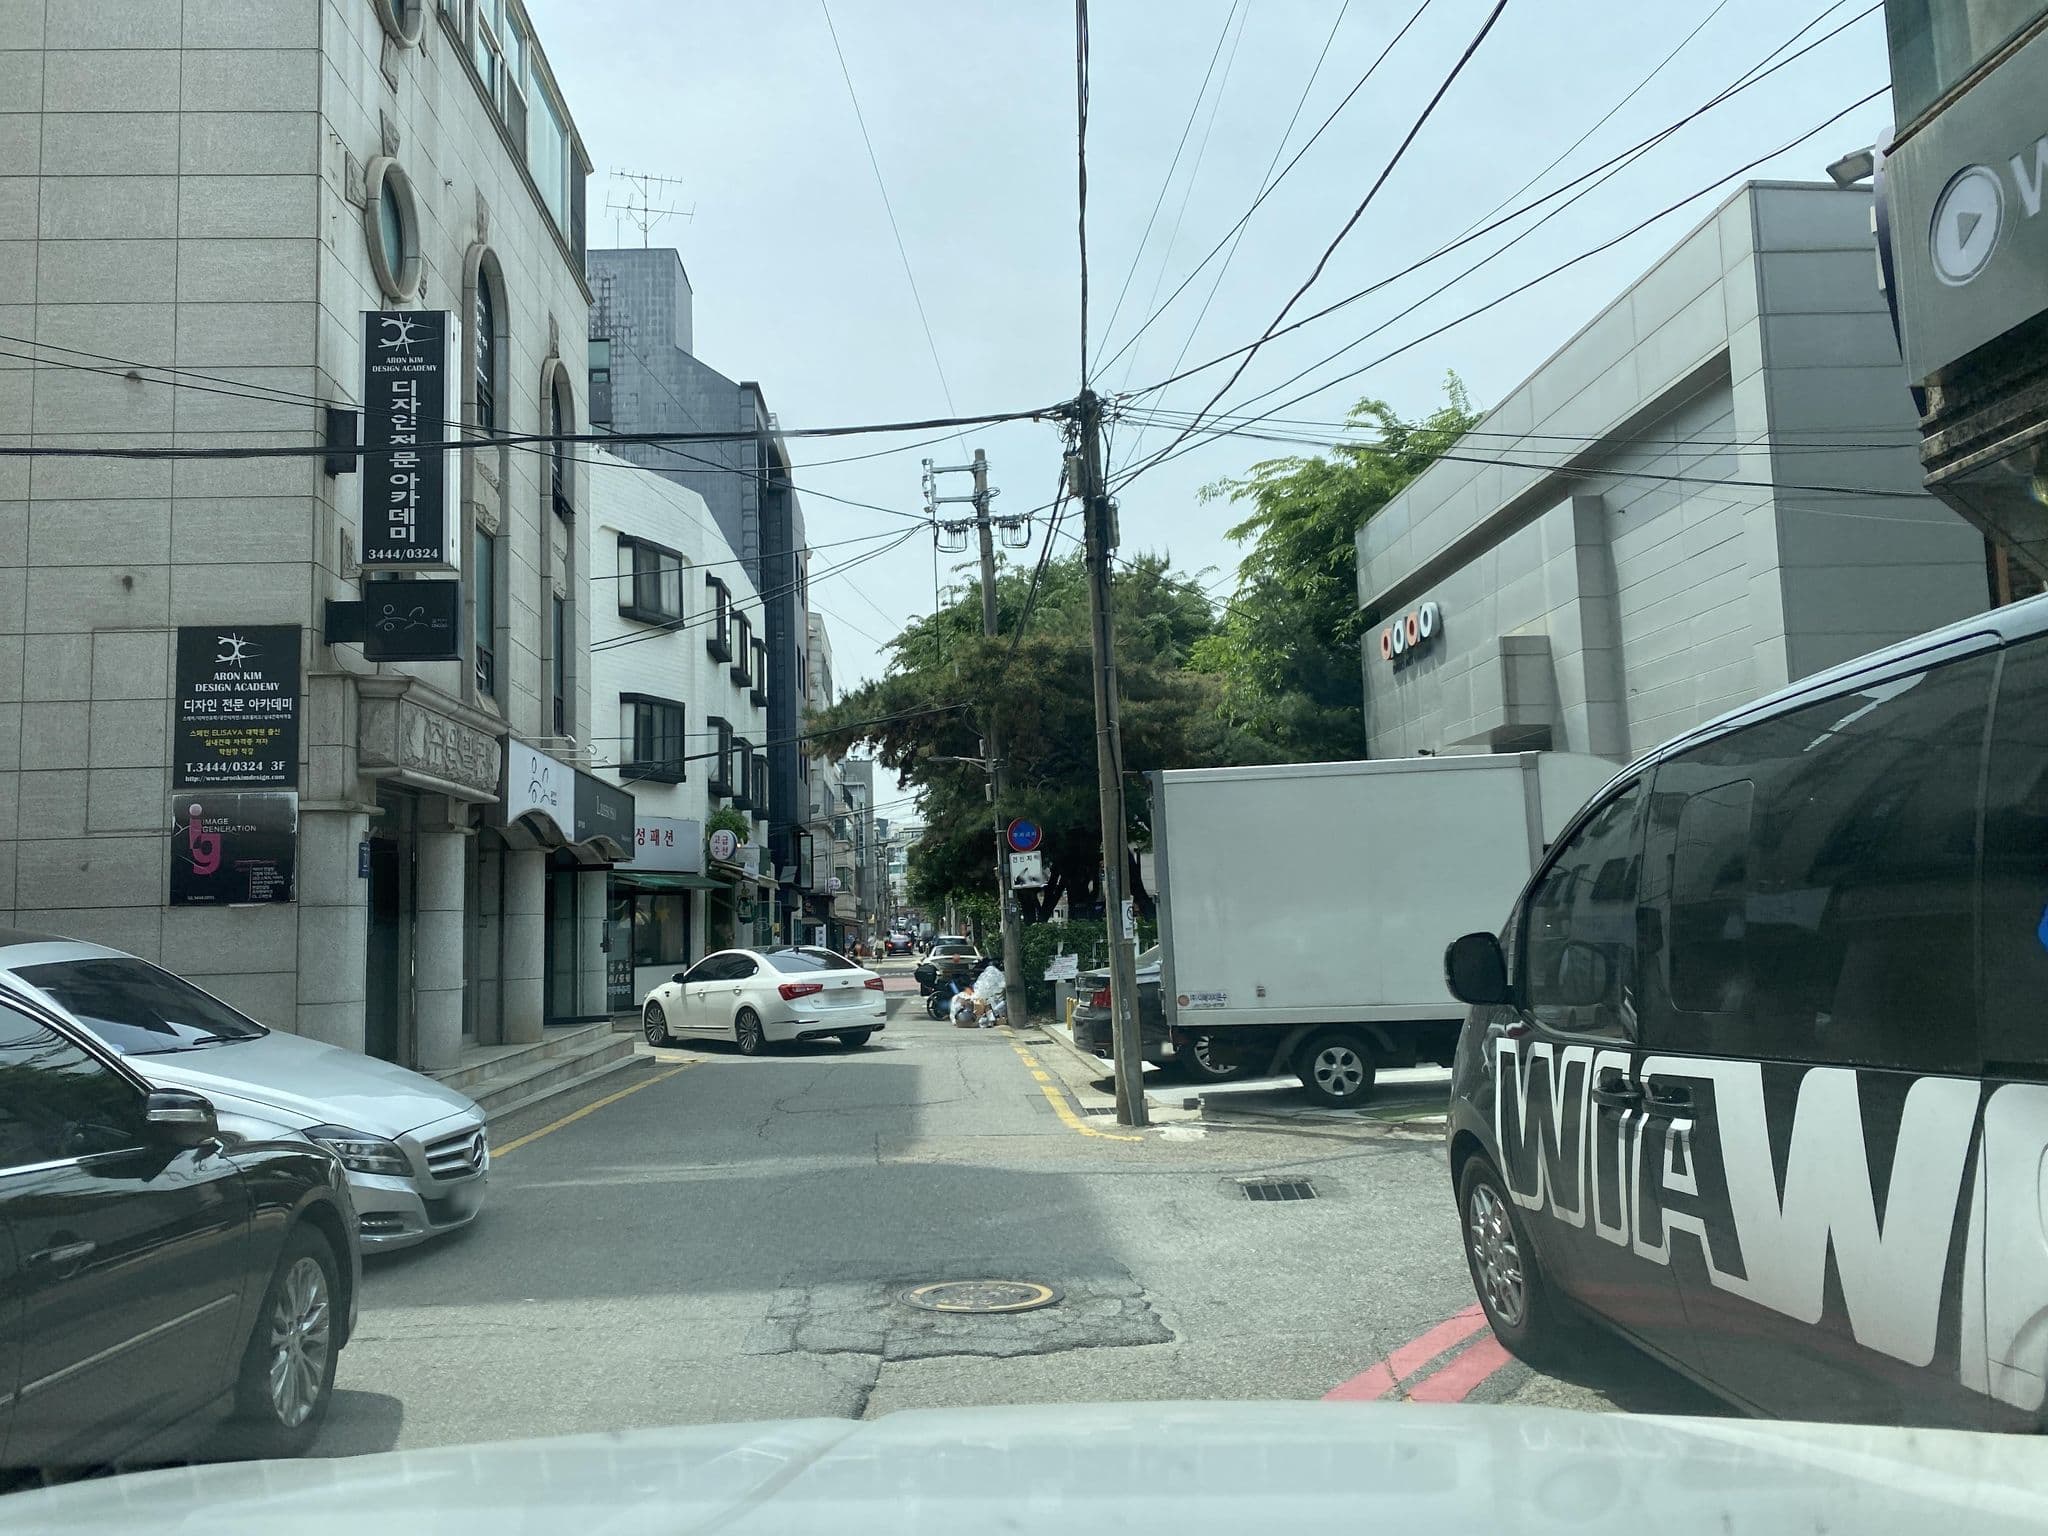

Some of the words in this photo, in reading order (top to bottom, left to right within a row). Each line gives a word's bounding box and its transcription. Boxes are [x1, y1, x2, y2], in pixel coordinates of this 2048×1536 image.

[402, 364, 438, 372] ACADEMY
[368, 548, 439, 560] 3444/0324
[213, 672, 241, 681] ARON
[243, 671, 262, 680] KIM
[195, 683, 232, 692] DESIGN
[234, 682, 280, 691] ACADEMY
[184, 699, 217, 712] 디자인
[222, 698, 245, 712] 전문
[248, 697, 293, 711] 아카데미
[185, 761, 263, 773] T.3444/0324
[270, 760, 286, 771] 3F
[202, 818, 229, 826] IMAGE
[202, 825, 257, 833] GENERATION
